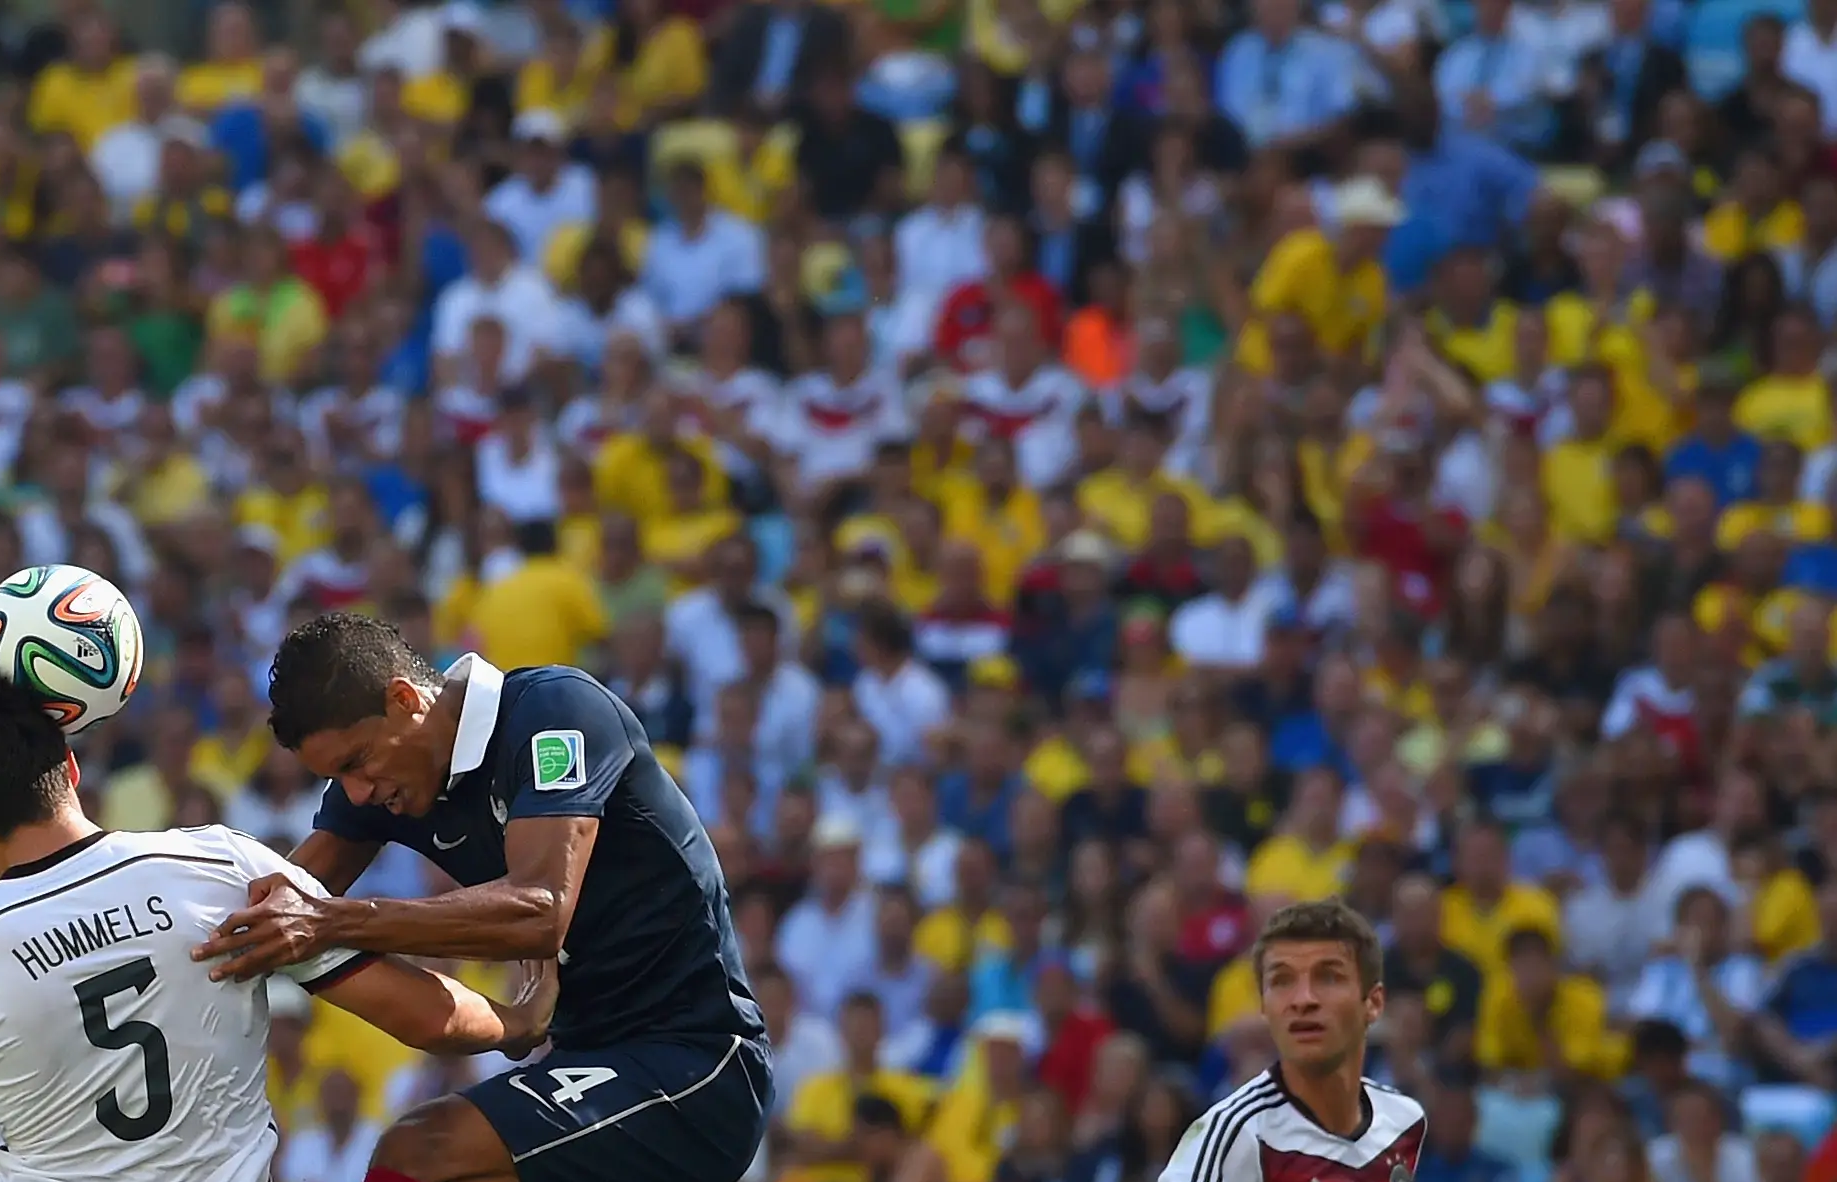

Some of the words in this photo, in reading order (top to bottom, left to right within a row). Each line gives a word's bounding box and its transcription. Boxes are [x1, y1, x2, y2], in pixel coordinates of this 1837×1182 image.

[11, 895, 173, 981] HUMMELS
[73, 956, 173, 1142] 5
[547, 1066, 619, 1103] 4
